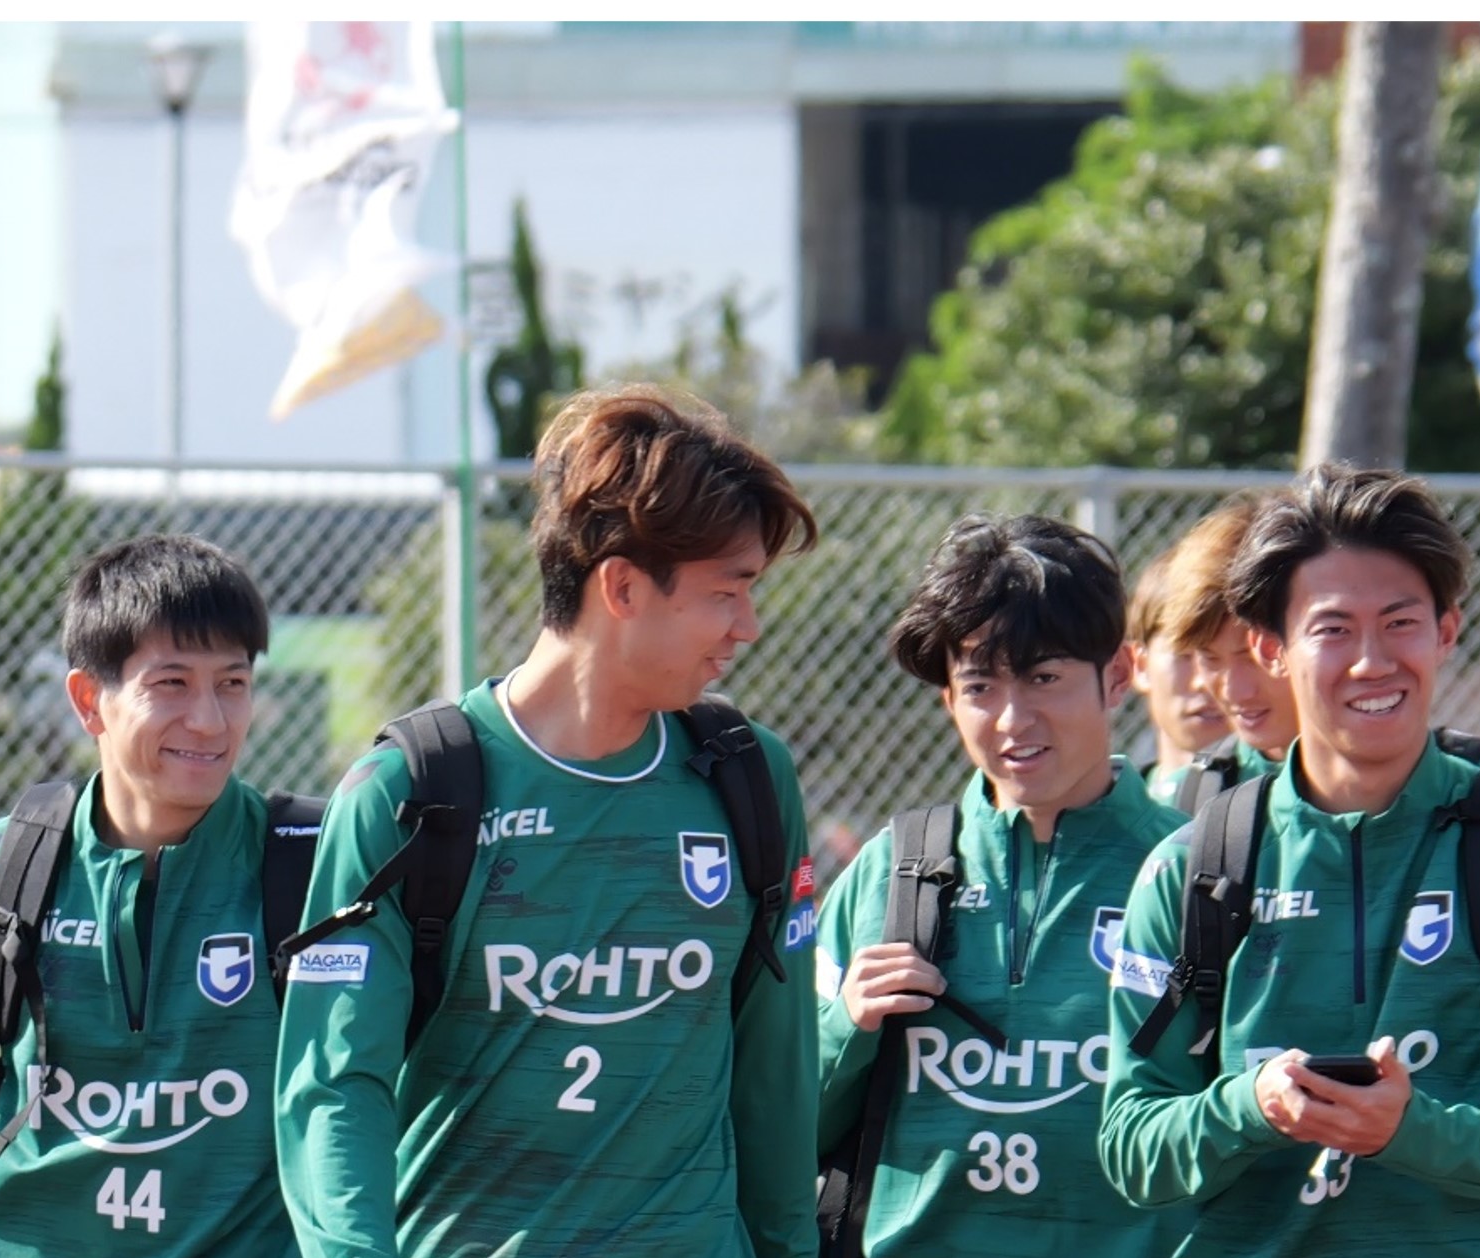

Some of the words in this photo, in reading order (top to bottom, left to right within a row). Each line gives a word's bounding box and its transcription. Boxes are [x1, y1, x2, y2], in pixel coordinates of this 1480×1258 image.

[477, 807, 555, 846] AICEL
[299, 954, 363, 967] NAGATA
[484, 939, 714, 1014] ROHTO
[27, 1065, 249, 1131] ROHTO
[557, 1045, 602, 1112] 2
[967, 1131, 1040, 1195] 38
[96, 1167, 166, 1233] 44
